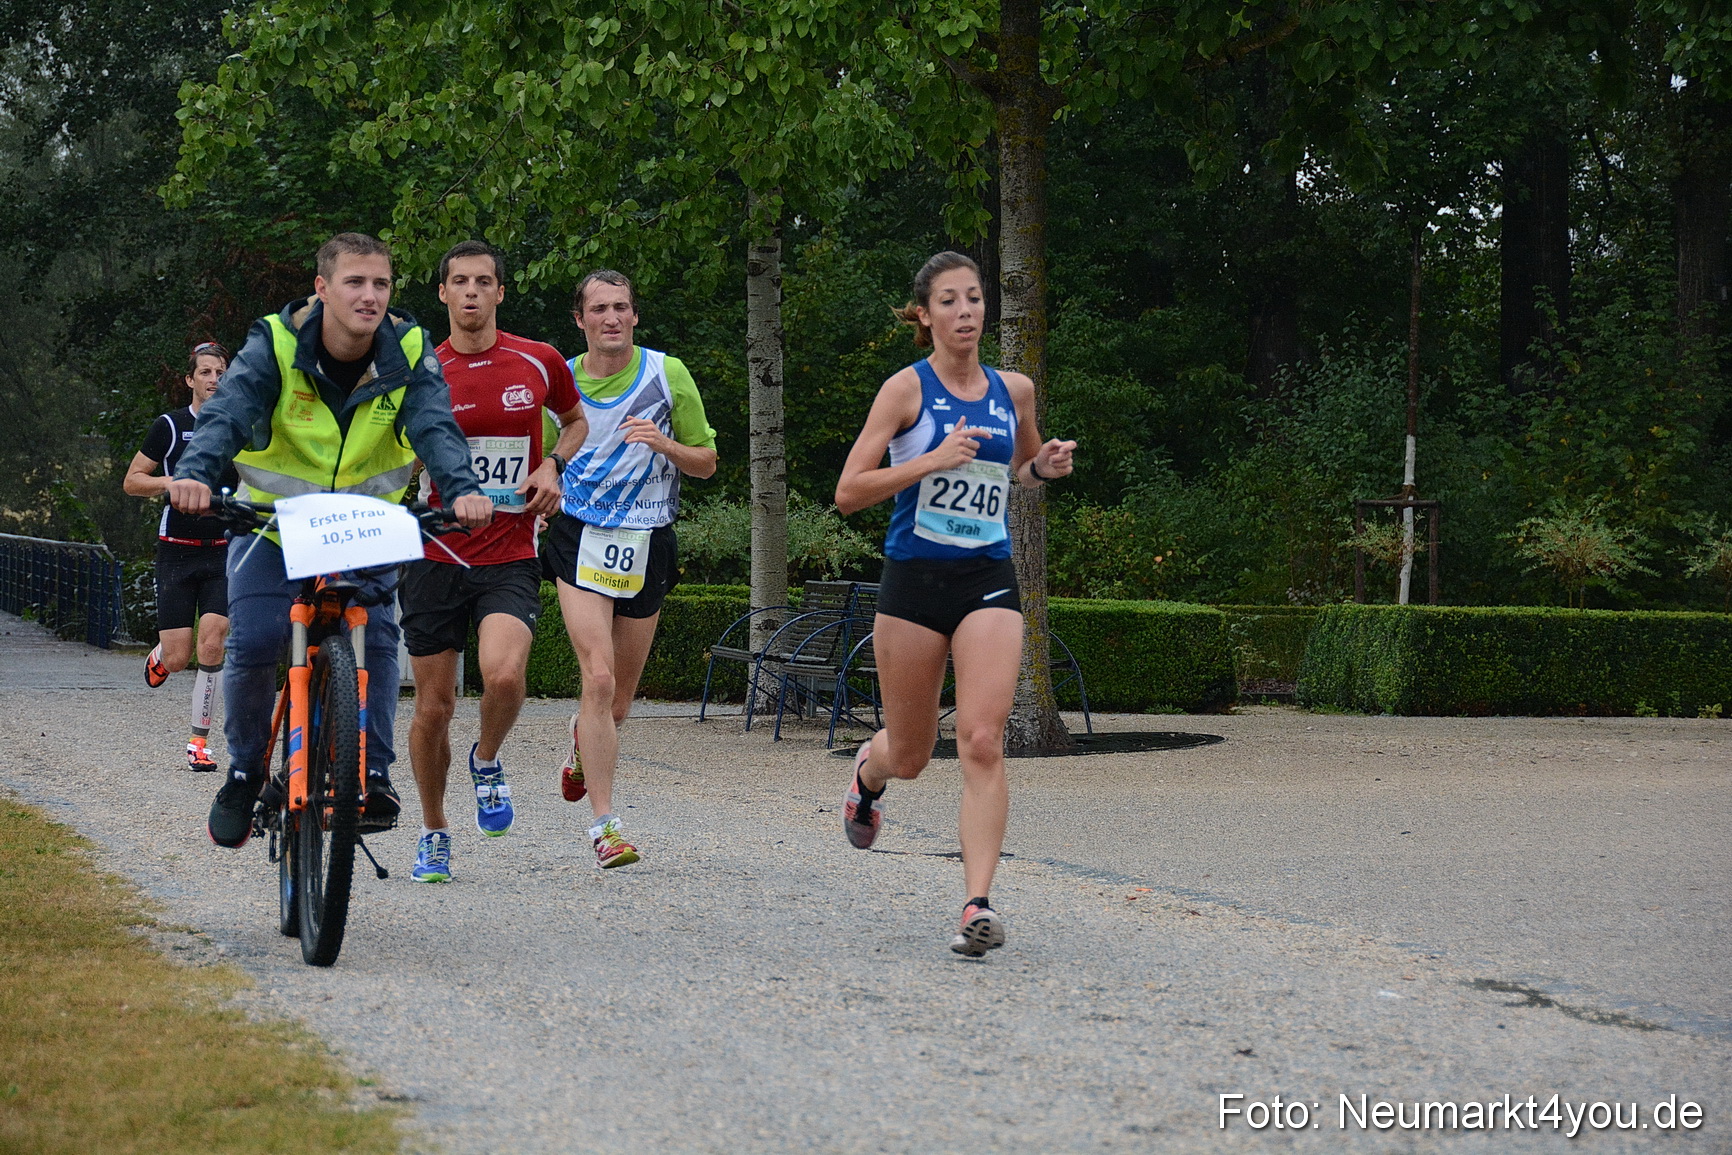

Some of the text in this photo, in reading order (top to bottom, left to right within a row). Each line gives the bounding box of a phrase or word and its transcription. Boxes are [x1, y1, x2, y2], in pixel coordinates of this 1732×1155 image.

[486, 440, 525, 450] BOCK
[594, 500, 632, 512] BIKES
[635, 497, 676, 511] Nürnrg
[929, 476, 1002, 517] 2246
[309, 508, 386, 528] Erste Frau
[321, 527, 382, 545] 10,5 km
[946, 519, 981, 536] Sarah
[603, 544, 635, 572] 98
[593, 572, 630, 589] Christin
